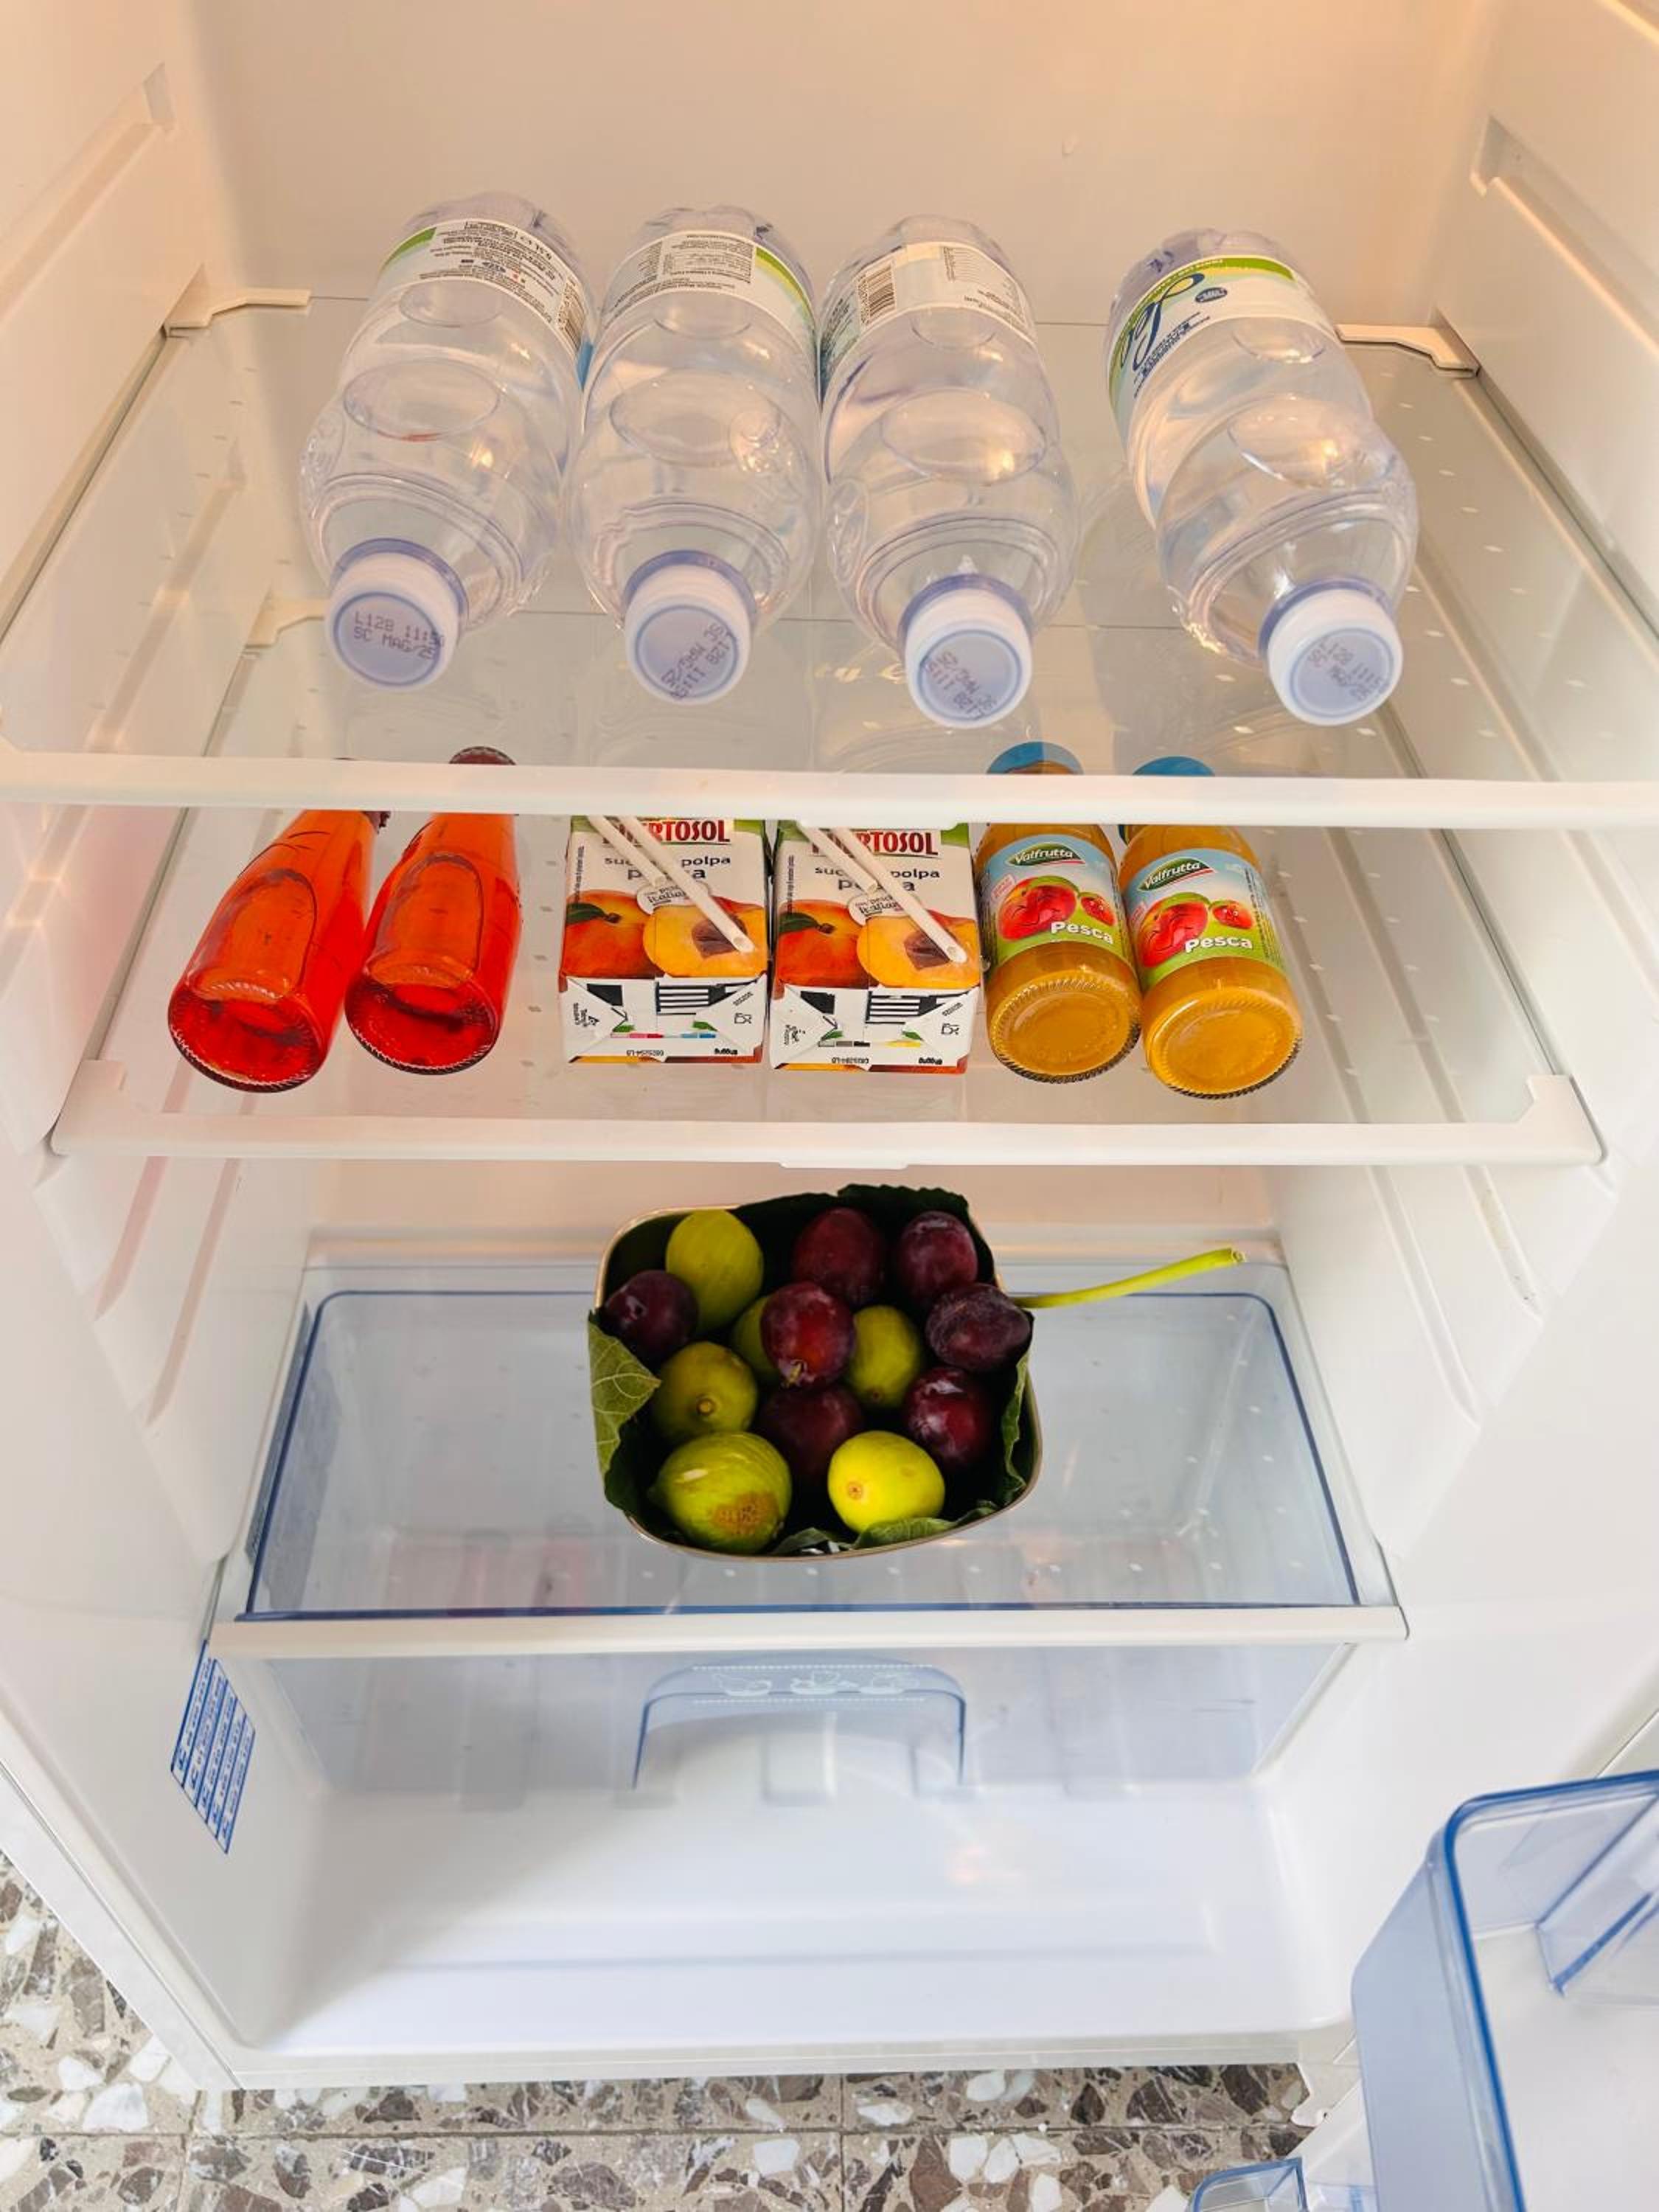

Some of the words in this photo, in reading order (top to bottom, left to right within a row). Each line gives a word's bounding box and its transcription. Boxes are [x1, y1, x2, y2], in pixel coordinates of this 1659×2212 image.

[354, 611, 394, 633] L128
[681, 855, 731, 869] polpa
[1014, 849, 1073, 864] Valfrutta
[1144, 862, 1200, 889] Valfrutta
